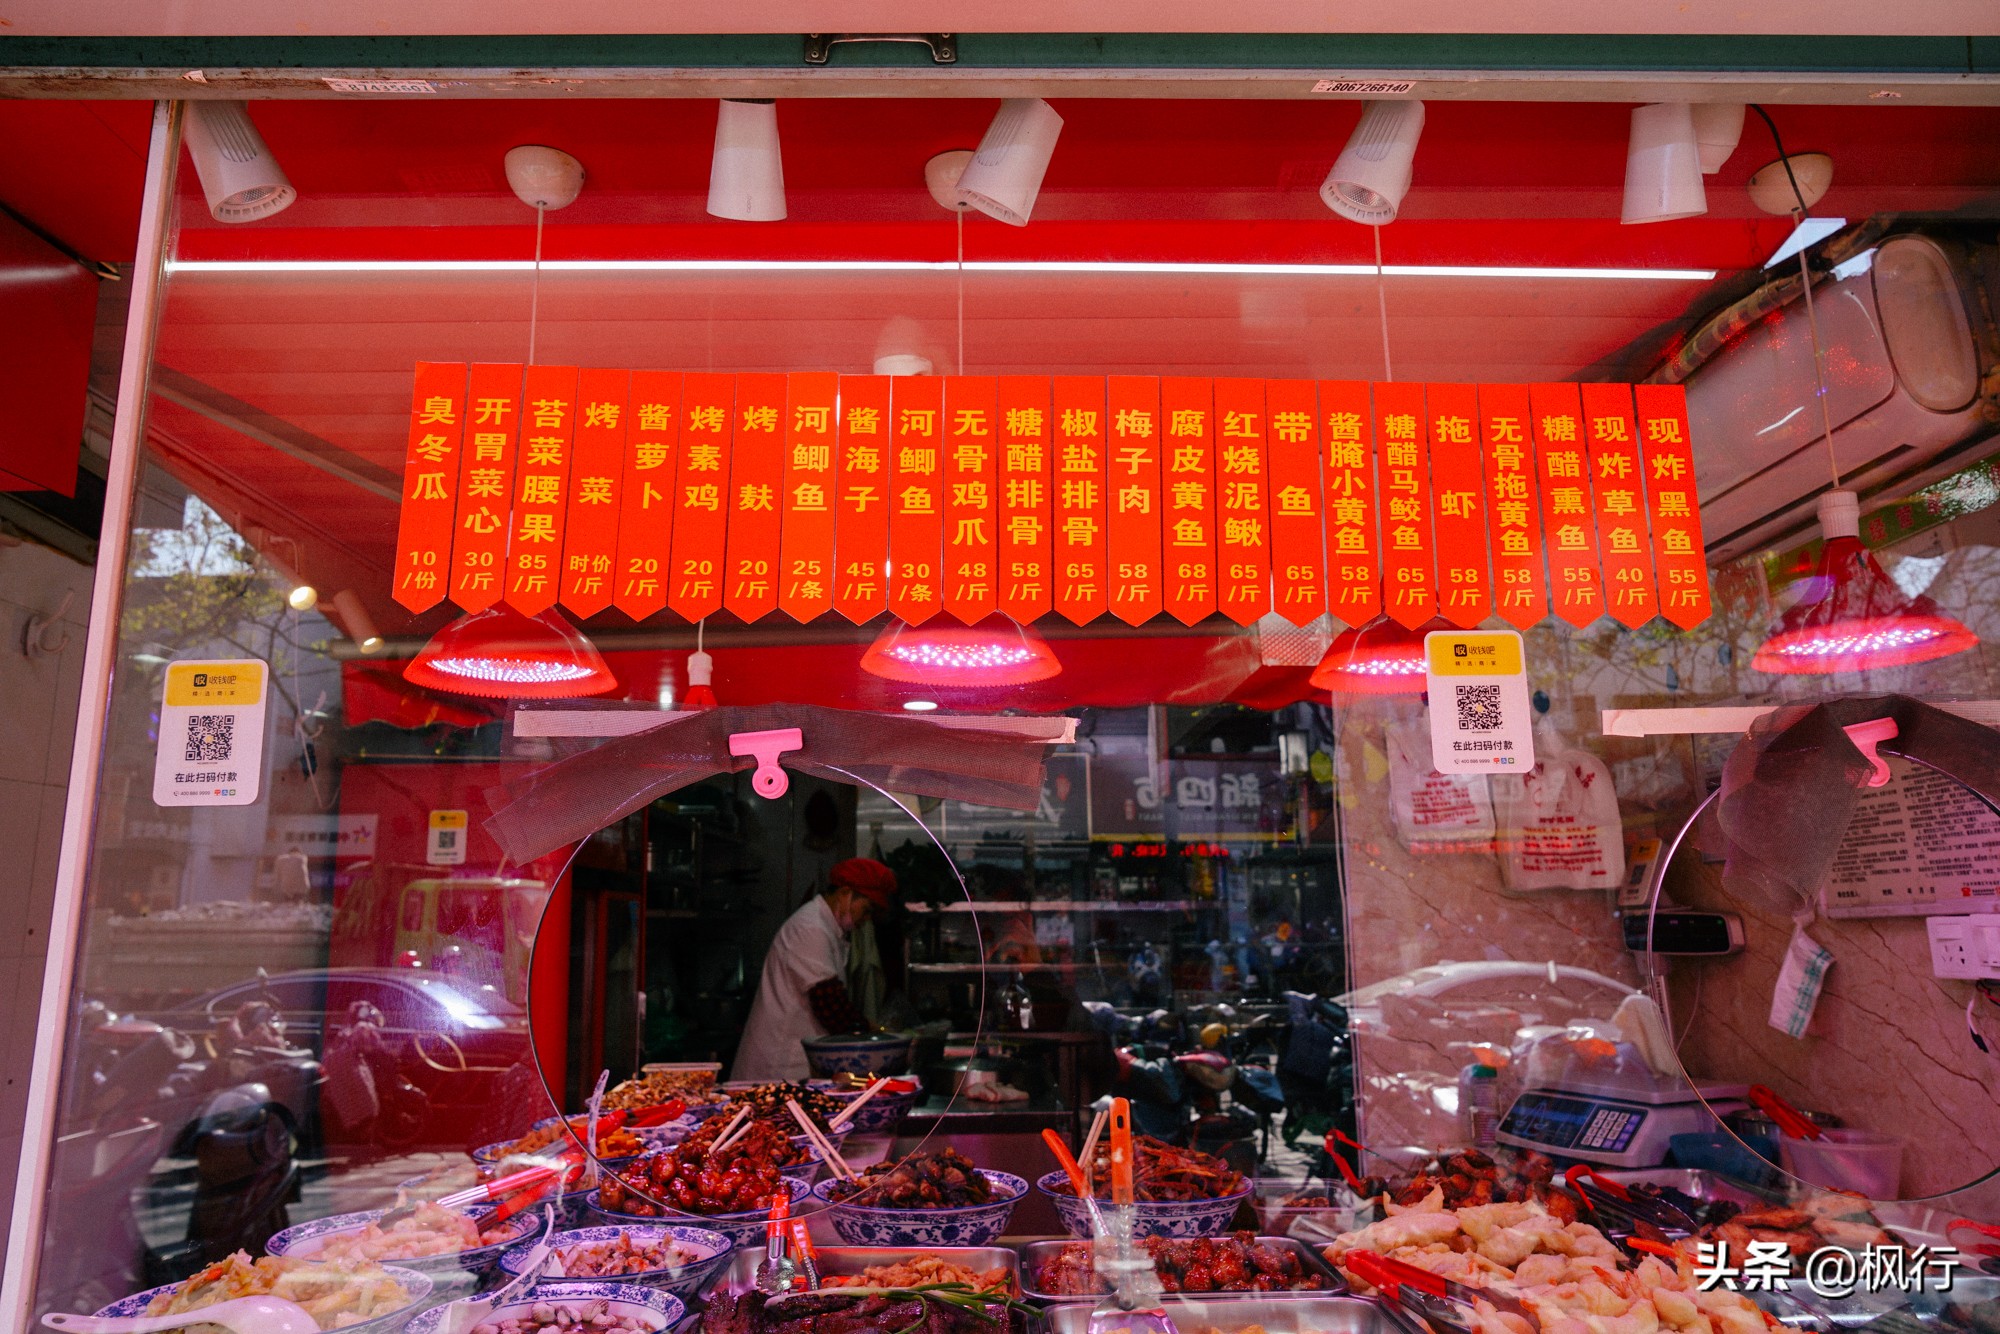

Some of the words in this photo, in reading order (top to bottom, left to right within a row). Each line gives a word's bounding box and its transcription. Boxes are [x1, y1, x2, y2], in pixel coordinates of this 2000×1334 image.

[410, 395, 456, 501] 臭冬瓜
[635, 403, 672, 510] 酱萝卜
[463, 398, 512, 534] 开胃菜心
[683, 405, 725, 512] 烤素鸡
[791, 405, 831, 512] 河鲫鱼
[844, 406, 881, 513] 酱海子
[898, 408, 936, 515] 河鲫鱼
[1114, 408, 1153, 515] 梅子肉
[518, 398, 569, 544] 苔菜腰果
[951, 409, 989, 546] 无骨鸡爪
[1005, 407, 1044, 546] 糖醋排骨
[1060, 408, 1099, 547] 椒盐排骨
[1169, 409, 1208, 547] 腐皮黄鱼
[1222, 410, 1263, 547] 红烧泥鳅
[1328, 411, 1370, 555] 酱腌小黄鱼
[1384, 413, 1424, 551] 糖醋马鲛鱼
[1490, 417, 1534, 557] 无骨拖黄鱼
[1541, 414, 1590, 556] 糖醋熏鱼
[1593, 416, 1643, 554] 现炸草鱼
[1647, 418, 1696, 556] 现炸黑鱼
[409, 551, 437, 566] 10
[464, 551, 494, 567] 30
[518, 553, 547, 570] 85
[569, 554, 612, 574] 时价
[628, 558, 658, 574] 20
[683, 559, 713, 576] 20
[738, 559, 769, 576] 20
[792, 559, 822, 576] 25
[846, 562, 875, 578] 45
[901, 563, 930, 579] 30
[957, 562, 987, 578] 48
[1011, 562, 1040, 578] 58
[1066, 562, 1095, 579] 65
[1119, 563, 1148, 579] 58
[1178, 563, 1207, 579] 68
[1229, 563, 1258, 580] 65
[1286, 565, 1315, 581] 65
[1341, 565, 1370, 581] 58
[1396, 567, 1425, 583] 65
[1450, 568, 1479, 584] 58
[1503, 568, 1532, 584] 58
[1563, 567, 1592, 583] 55
[1615, 567, 1644, 583] 40
[1668, 569, 1697, 584] 55
[401, 570, 437, 590] /份
[459, 571, 495, 591] /斤
[513, 574, 548, 593] /斤
[572, 576, 603, 595] /斤
[624, 578, 659, 597] /斤
[679, 580, 714, 599] /斤
[734, 580, 770, 599] /斤
[788, 579, 824, 600] /条
[842, 582, 878, 601] /斤
[898, 583, 933, 603] /条
[955, 582, 990, 601] /斤
[1008, 582, 1043, 601] /斤
[1063, 583, 1098, 602] /斤
[1116, 583, 1151, 603] /斤
[1175, 583, 1210, 602] /斤
[1227, 584, 1261, 603] /斤
[1284, 585, 1318, 604] /斤
[1339, 585, 1373, 604] /斤
[1395, 587, 1429, 606] /斤
[1449, 588, 1482, 607] /斤
[1503, 588, 1536, 607] /斤
[1564, 586, 1597, 606] /斤
[1616, 587, 1649, 606] /斤
[1669, 588, 1702, 607] /斤
[1452, 740, 1514, 751] 在此扫码付款
[174, 772, 238, 783] 在此扫码付款
